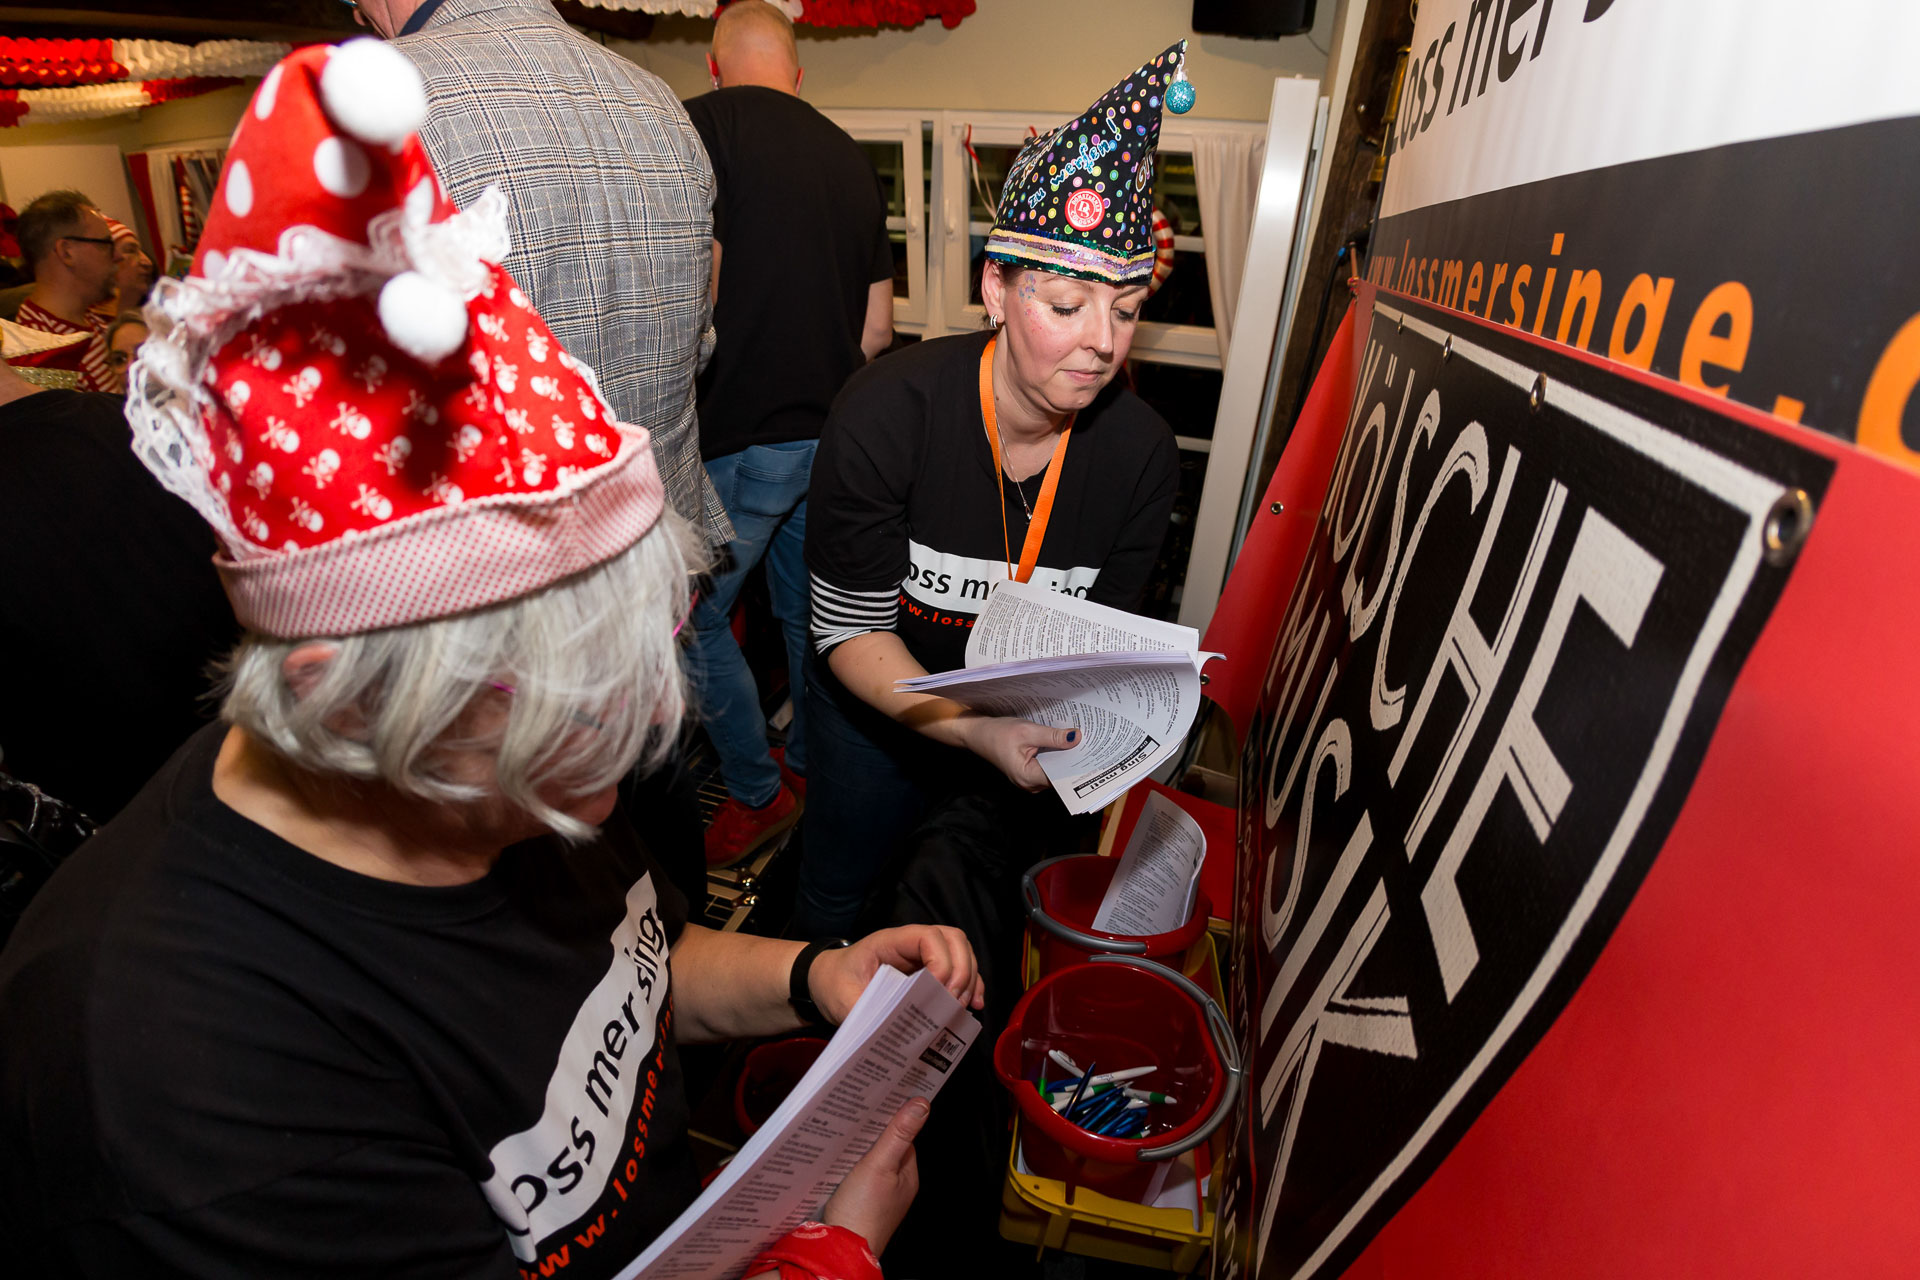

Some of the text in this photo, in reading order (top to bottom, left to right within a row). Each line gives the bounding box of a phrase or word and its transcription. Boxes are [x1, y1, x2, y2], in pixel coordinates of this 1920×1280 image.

[1257, 550, 1418, 1280] MUSIK
[1324, 339, 1665, 1004] KÖLSCHE
[585, 991, 640, 1119] mer
